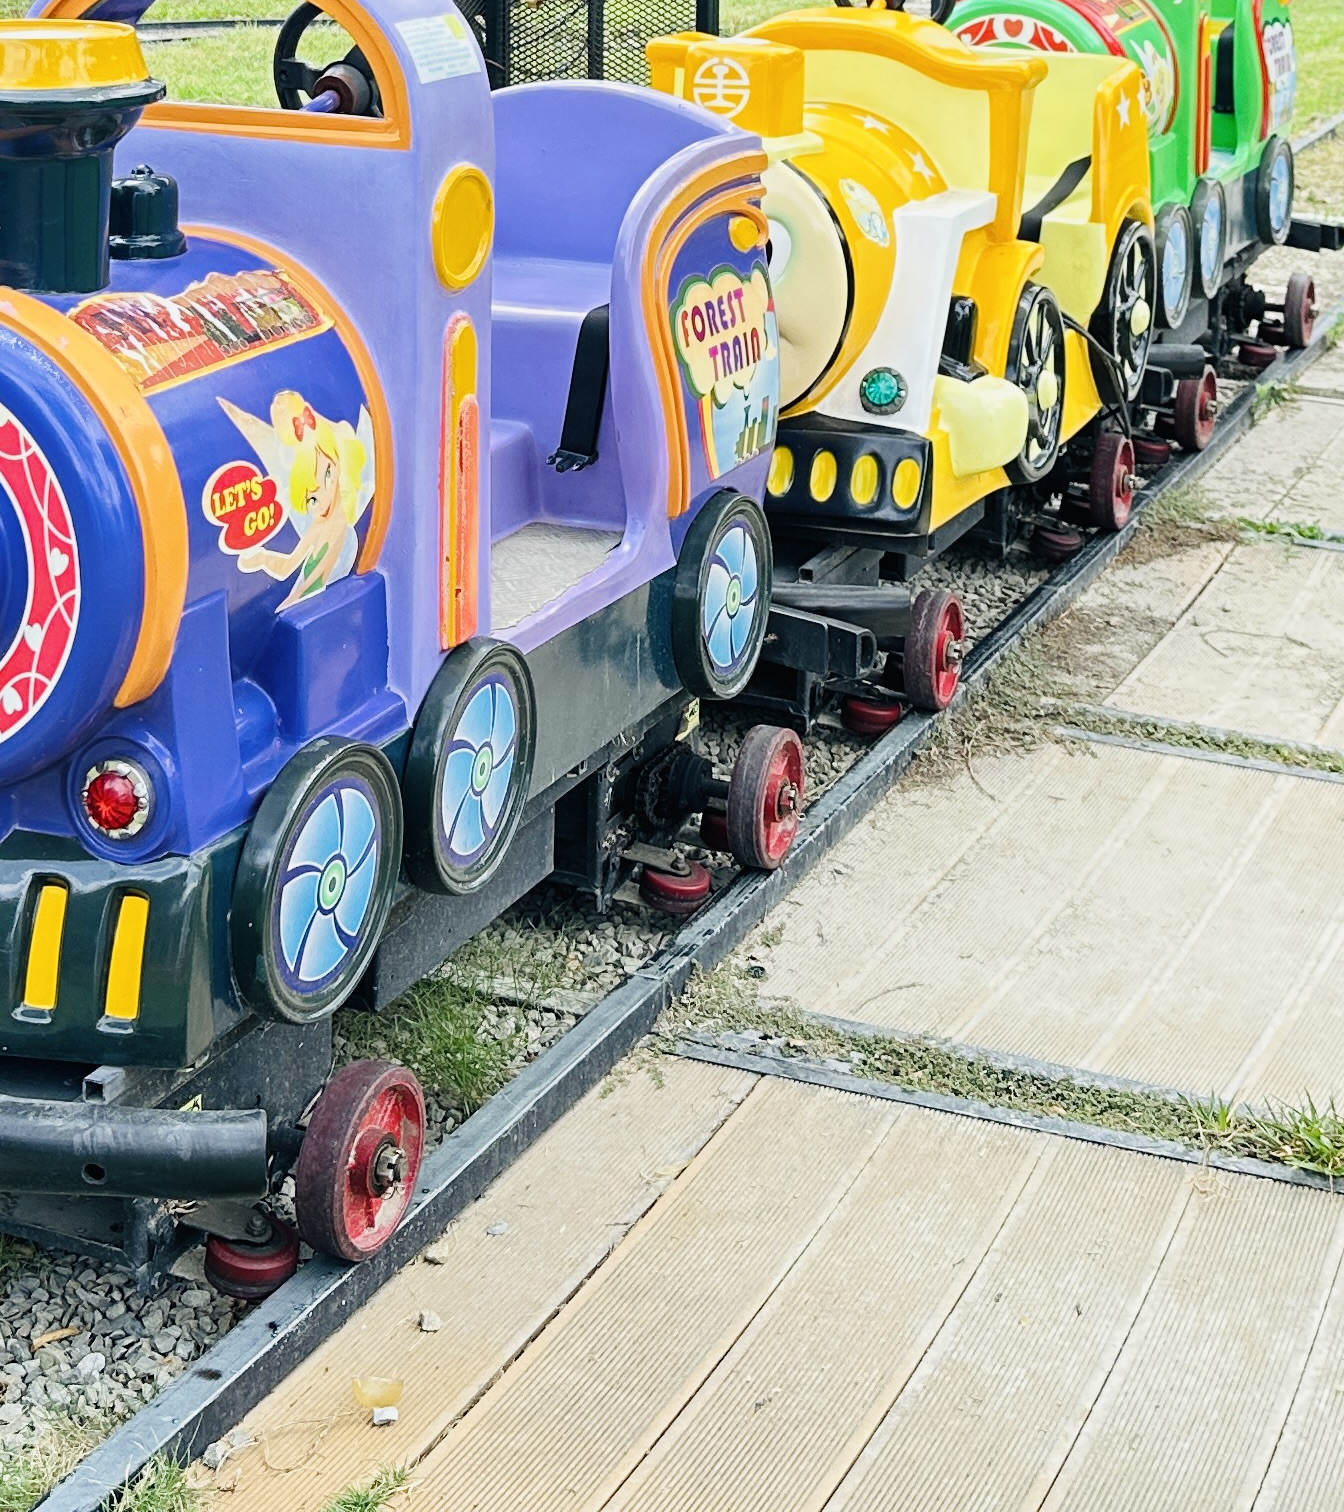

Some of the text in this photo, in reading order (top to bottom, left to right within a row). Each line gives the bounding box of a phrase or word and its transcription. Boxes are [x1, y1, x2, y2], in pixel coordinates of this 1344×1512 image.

[681, 287, 746, 349] FOREST
[708, 326, 761, 382] TRAIN
[212, 476, 263, 518] LET'S
[243, 502, 275, 537] GO!
